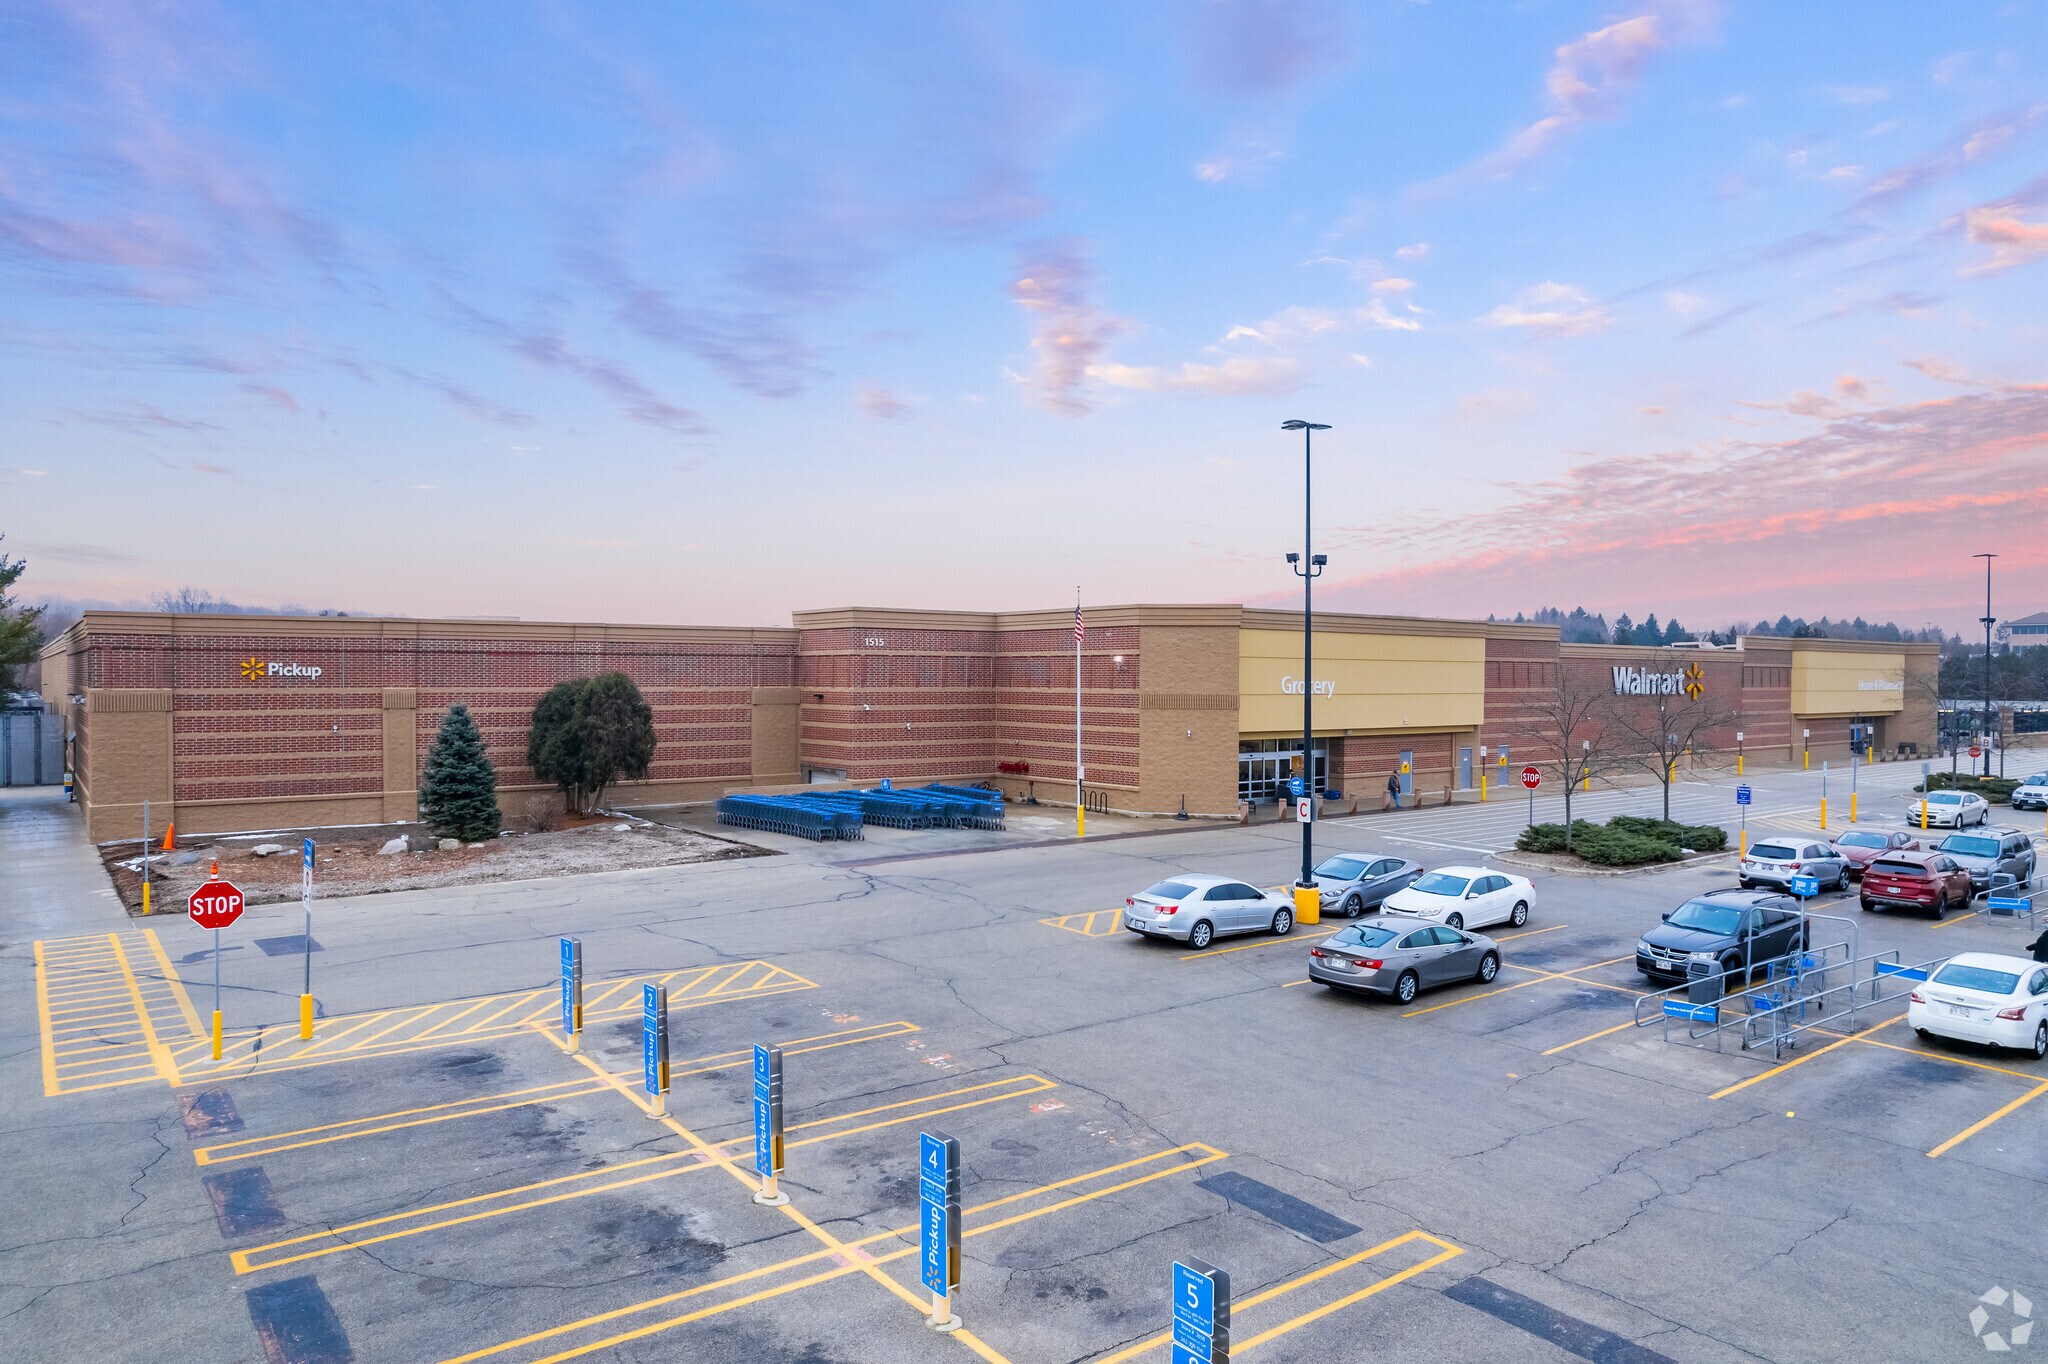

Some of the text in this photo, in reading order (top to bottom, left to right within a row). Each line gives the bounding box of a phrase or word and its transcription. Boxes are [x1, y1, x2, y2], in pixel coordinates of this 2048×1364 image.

[864, 638, 884, 646] 1515
[268, 662, 322, 680] Pickup
[1612, 666, 1685, 695] Walmart
[1858, 680, 1874, 690] Home
[1984, 739, 1989, 747] B
[1522, 773, 1539, 782] STOP
[1300, 802, 1307, 817] C
[192, 895, 240, 916] STOP
[565, 946, 569, 957] 1
[648, 993, 652, 1007] 2
[759, 1056, 764, 1072] 3
[929, 1150, 938, 1169] 4
[929, 1207, 941, 1266] Pickup
[1182, 1270, 1204, 1285] Reserved
[1187, 1283, 1199, 1308] 5
